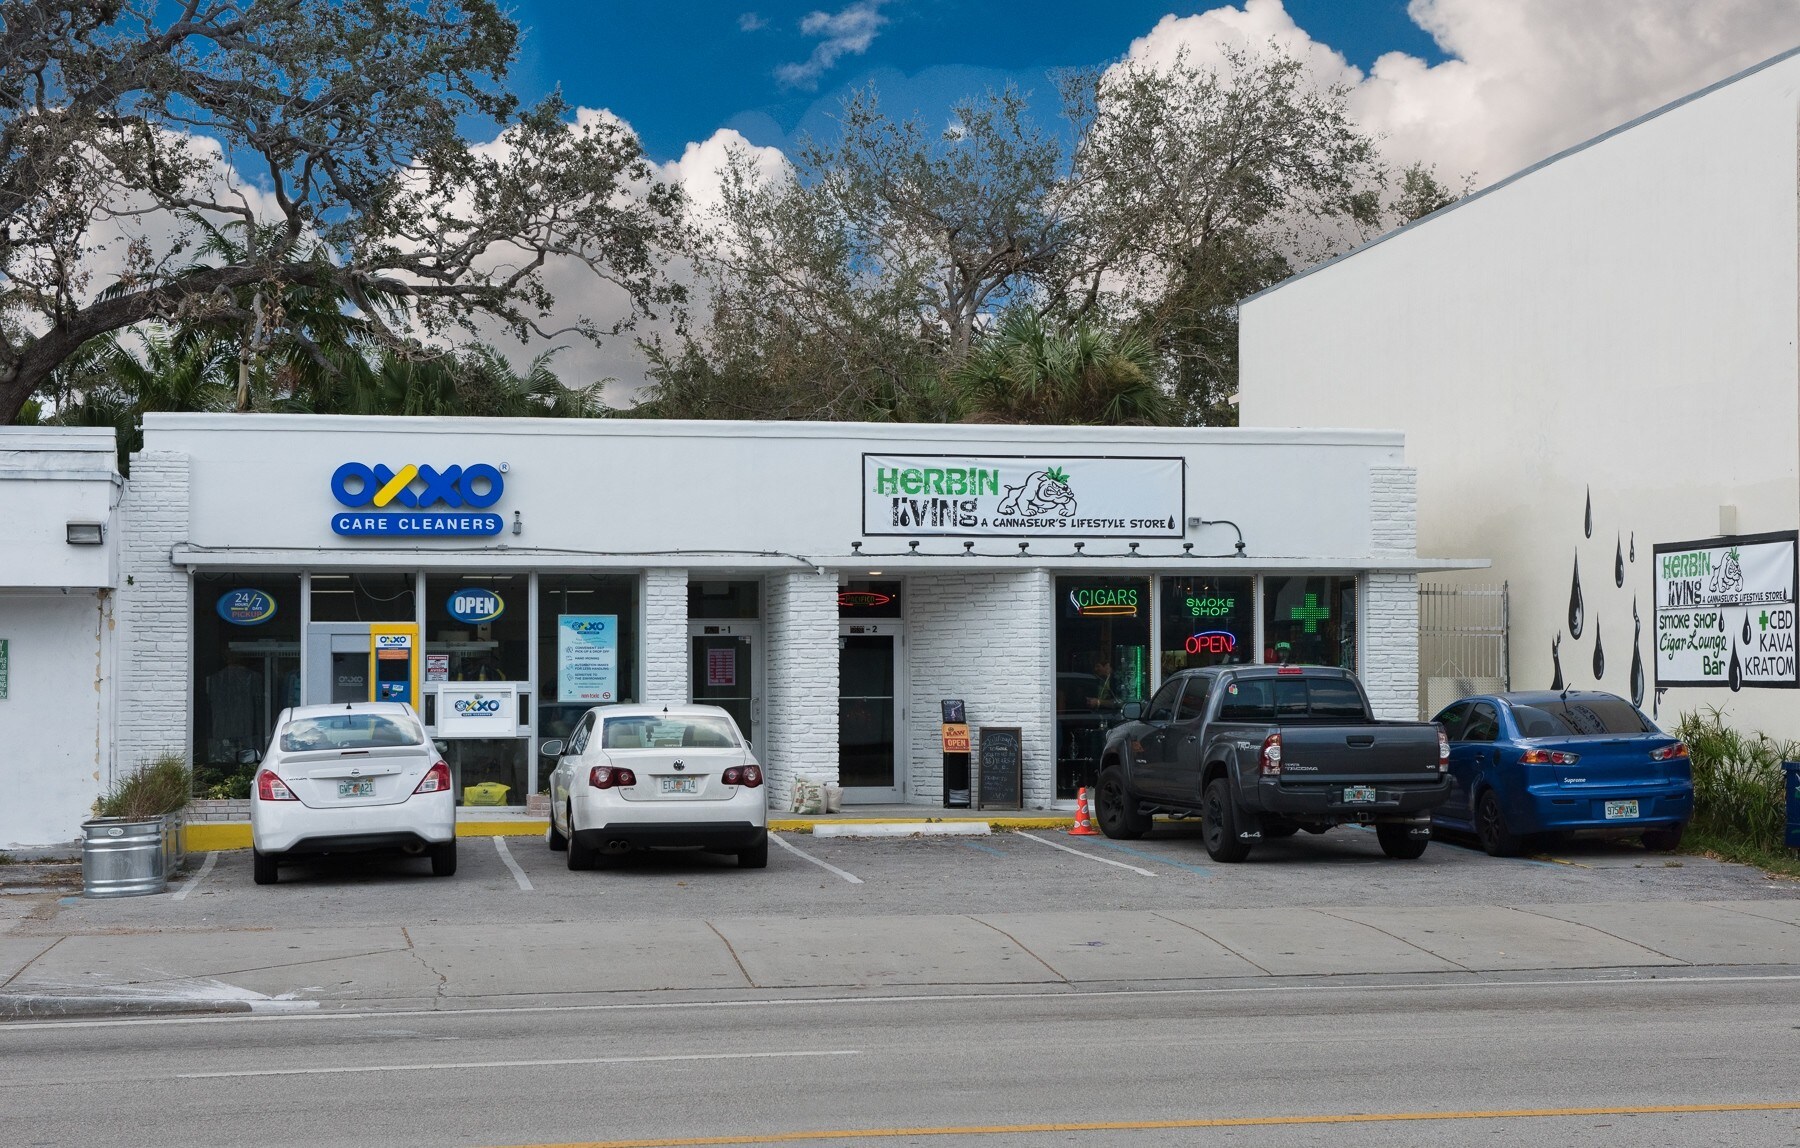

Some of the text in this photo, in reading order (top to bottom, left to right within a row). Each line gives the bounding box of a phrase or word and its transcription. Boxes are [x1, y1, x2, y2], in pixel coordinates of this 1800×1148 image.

[331, 462, 504, 508] OXXO
[339, 518, 495, 530] CARE CLEANERS
[981, 518, 1166, 528] A CANNASEUR'S LIFESTYLE STORE
[455, 596, 495, 614] OPEN
[1079, 589, 1138, 607] CIGARS
[1186, 598, 1235, 607] SMOKE
[1706, 593, 1739, 604] CANNASEUR'S
[1740, 591, 1764, 601] LIFESTYLE
[1765, 590, 1783, 600] STORE
[1191, 607, 1229, 616] SHOP
[1769, 610, 1793, 629] CBD
[1694, 612, 1717, 628] SHOP
[1186, 636, 1233, 654] OPEN
[1659, 629, 1728, 660] Cigar Lounge
[1760, 632, 1794, 652] KAVA
[1703, 655, 1726, 676] Bar
[1744, 656, 1795, 676] KRATOM
[454, 700, 500, 712] OXXO
[947, 739, 966, 747] OPEN
[1237, 741, 1251, 751] TRD
[1607, 806, 1619, 815] 975
